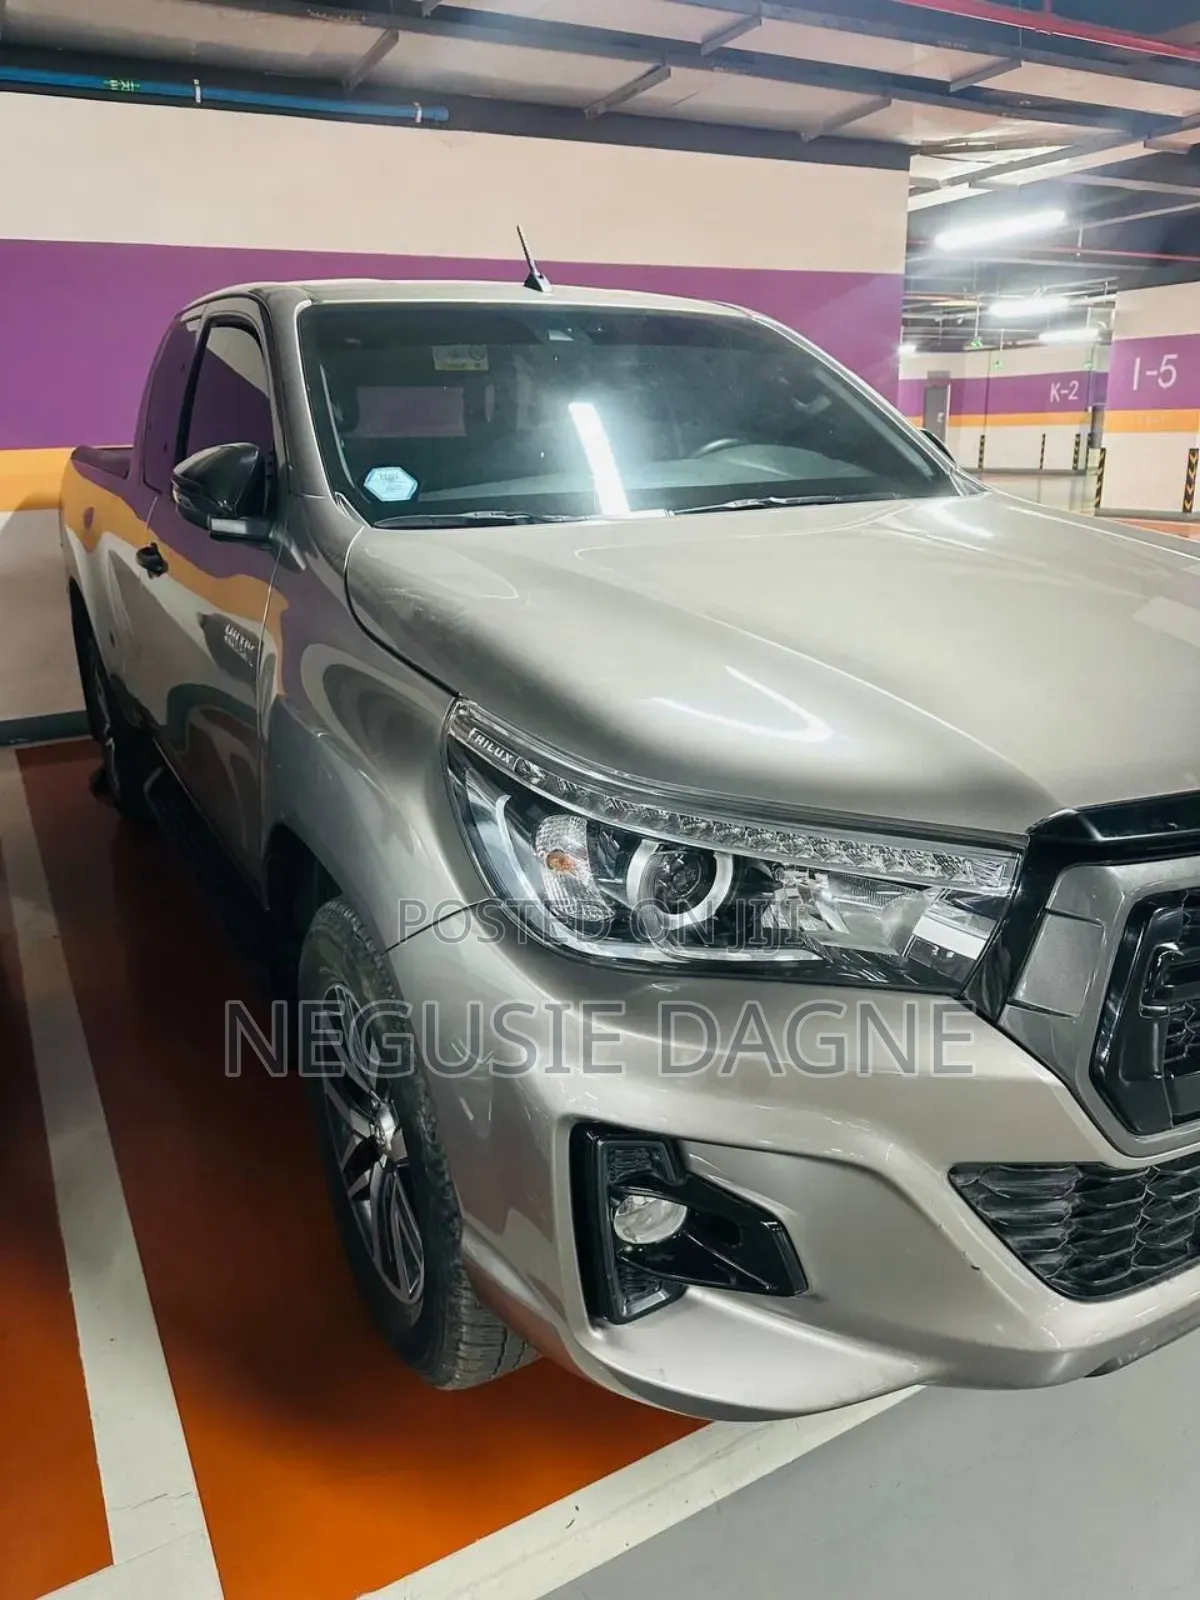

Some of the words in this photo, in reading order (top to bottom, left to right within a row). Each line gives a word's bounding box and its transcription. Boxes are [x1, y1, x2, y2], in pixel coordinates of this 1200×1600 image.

[1132, 353, 1179, 391] I-5
[1050, 380, 1079, 402] K-2
[474, 734, 514, 764] HILUX
